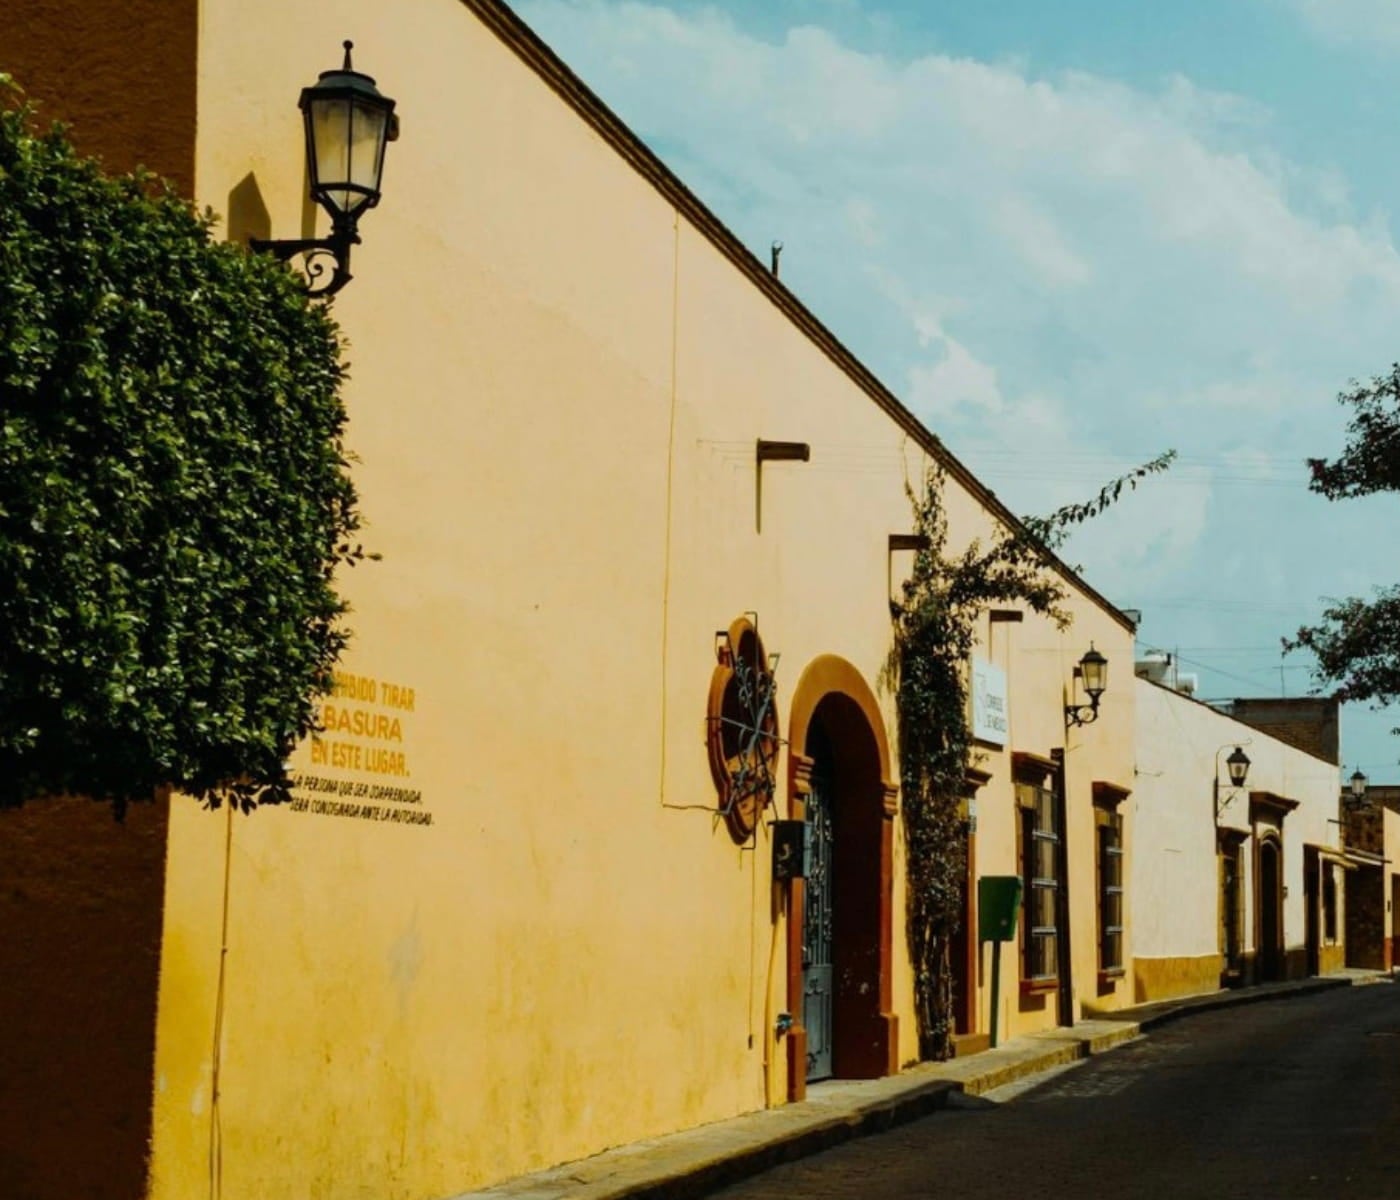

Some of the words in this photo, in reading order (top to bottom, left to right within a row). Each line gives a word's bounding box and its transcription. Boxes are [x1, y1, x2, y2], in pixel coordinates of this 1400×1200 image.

[331, 671, 376, 702] HIBIDO
[381, 681, 416, 712] TIRAR
[324, 704, 403, 743] BASURA
[311, 737, 328, 766] EN
[331, 741, 361, 770] ESTE
[365, 747, 411, 778] LUGAR.
